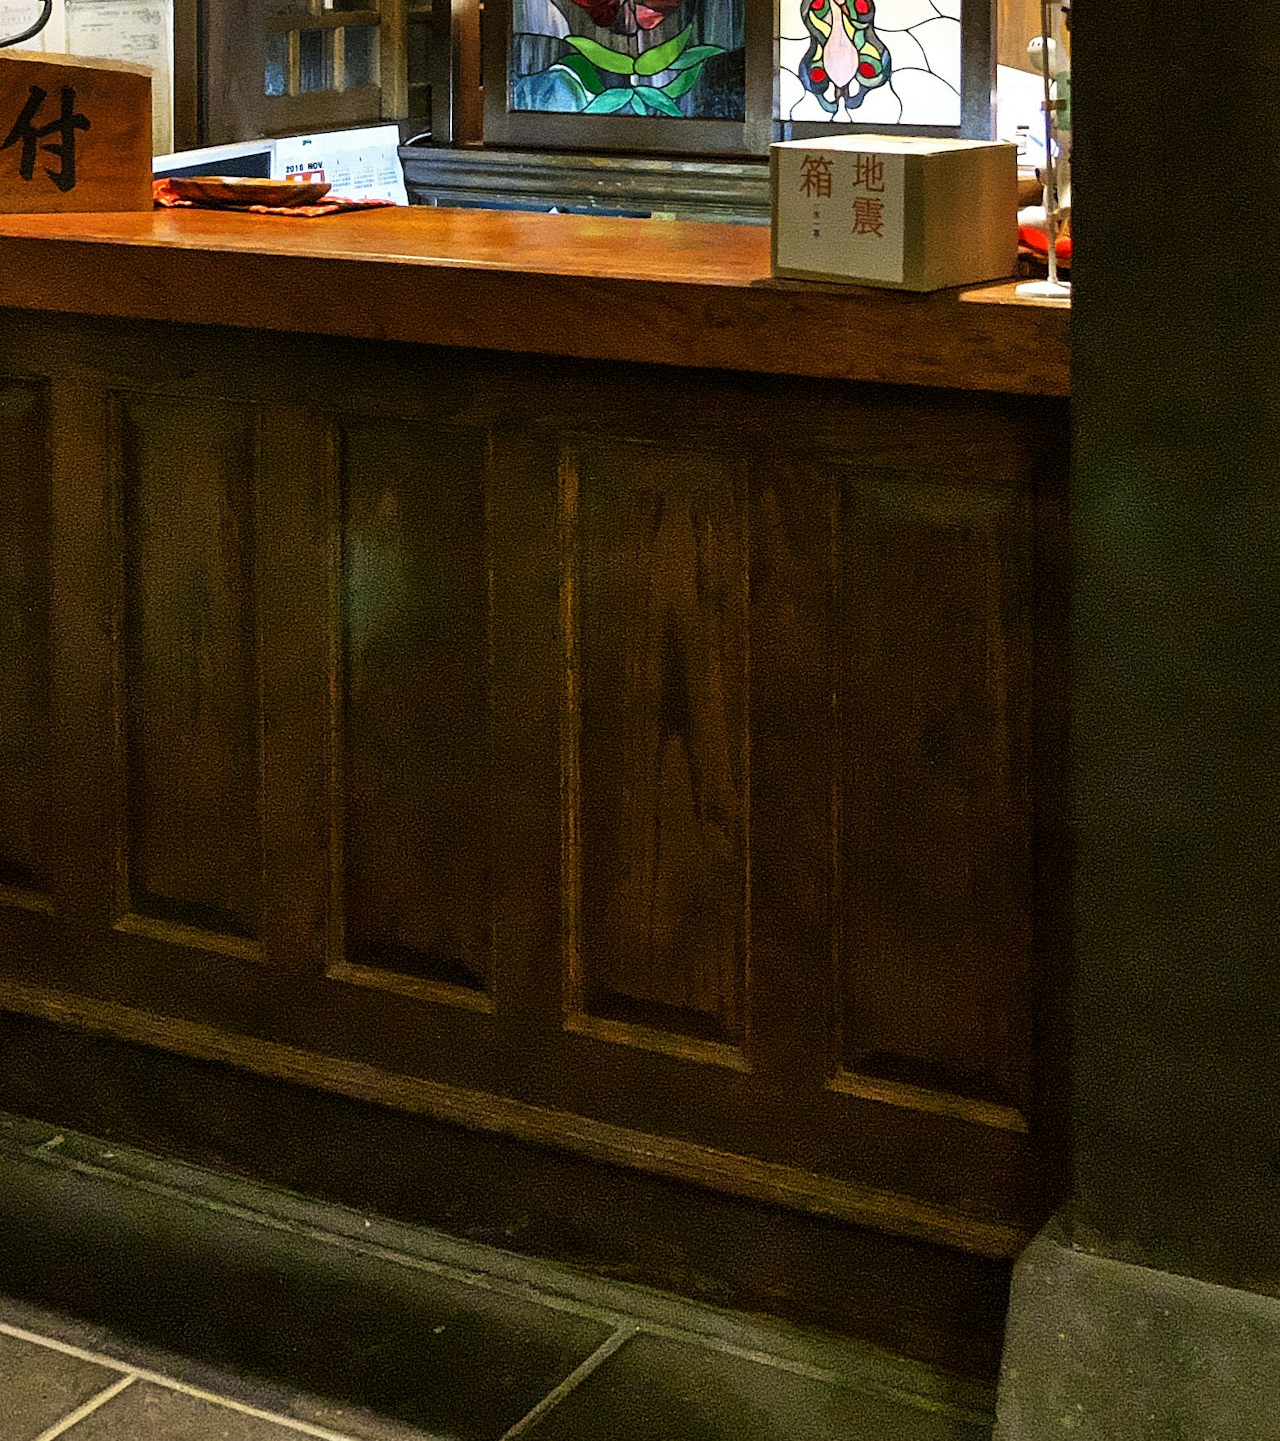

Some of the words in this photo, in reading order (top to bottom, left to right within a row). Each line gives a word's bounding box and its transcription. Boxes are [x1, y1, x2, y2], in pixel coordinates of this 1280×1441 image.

[307, 161, 323, 170] NOV
[799, 153, 835, 199] 箱
[851, 153, 886, 238] 地震
